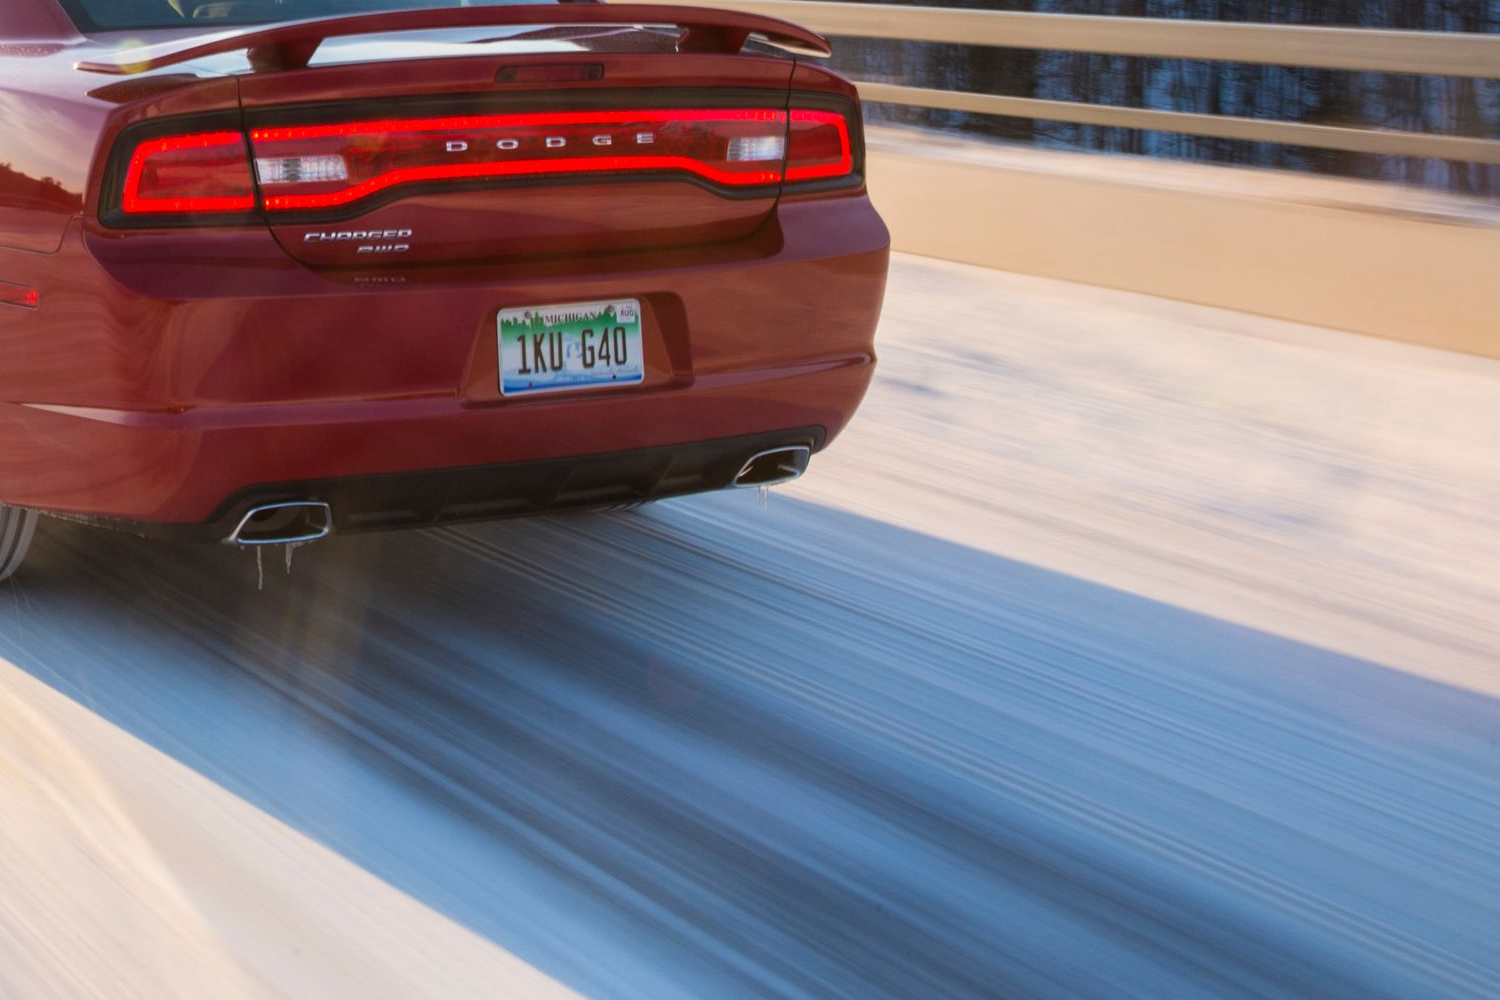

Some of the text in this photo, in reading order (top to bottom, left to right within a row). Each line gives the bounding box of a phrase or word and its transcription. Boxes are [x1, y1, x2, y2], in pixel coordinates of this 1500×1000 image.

[445, 132, 654, 152] DODGE
[304, 229, 412, 243] CHARGER
[545, 311, 597, 324] MICHIGAN
[517, 326, 627, 375] 1KU G40
